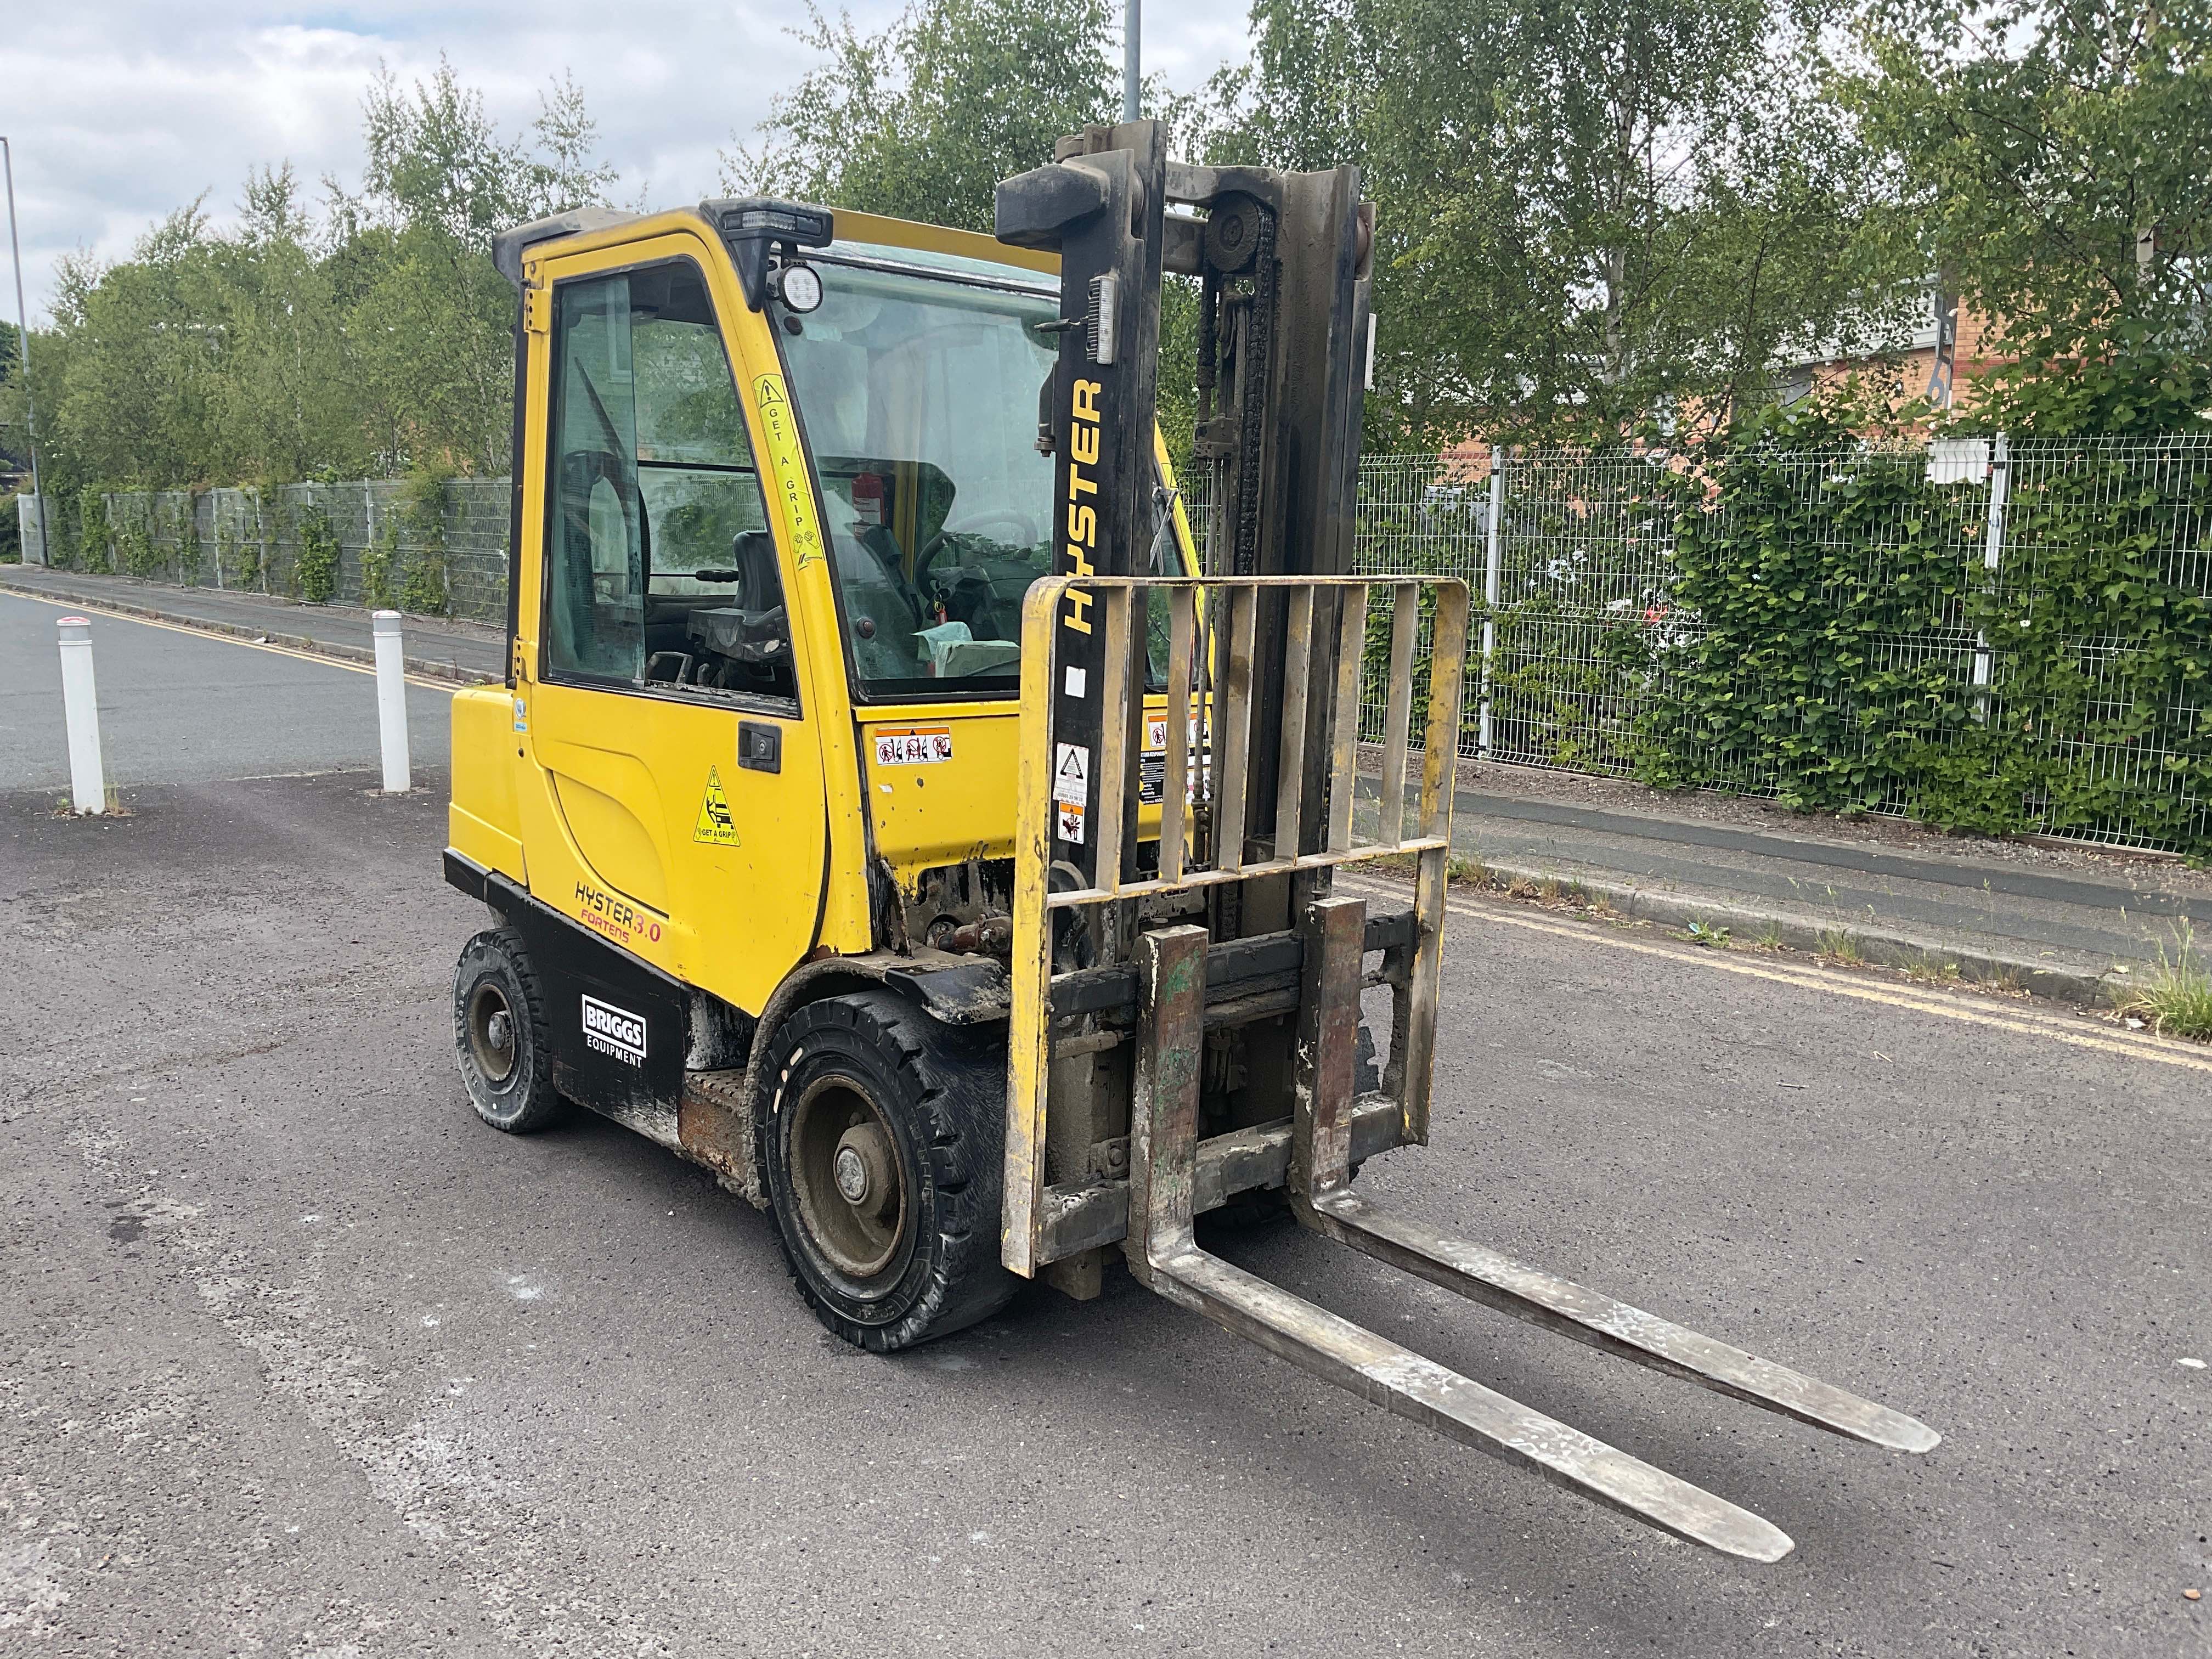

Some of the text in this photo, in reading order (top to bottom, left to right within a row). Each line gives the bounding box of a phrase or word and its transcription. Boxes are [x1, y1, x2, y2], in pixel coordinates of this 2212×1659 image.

[769, 408, 803, 526] GET A GRIP
[1064, 379, 1102, 635] HYSTER
[575, 881, 661, 943] HYSTER 3.0
[581, 909, 630, 944] FORTENS
[586, 1005, 642, 1046] BRIGGS
[587, 1035, 642, 1068] EQUIPMENT
